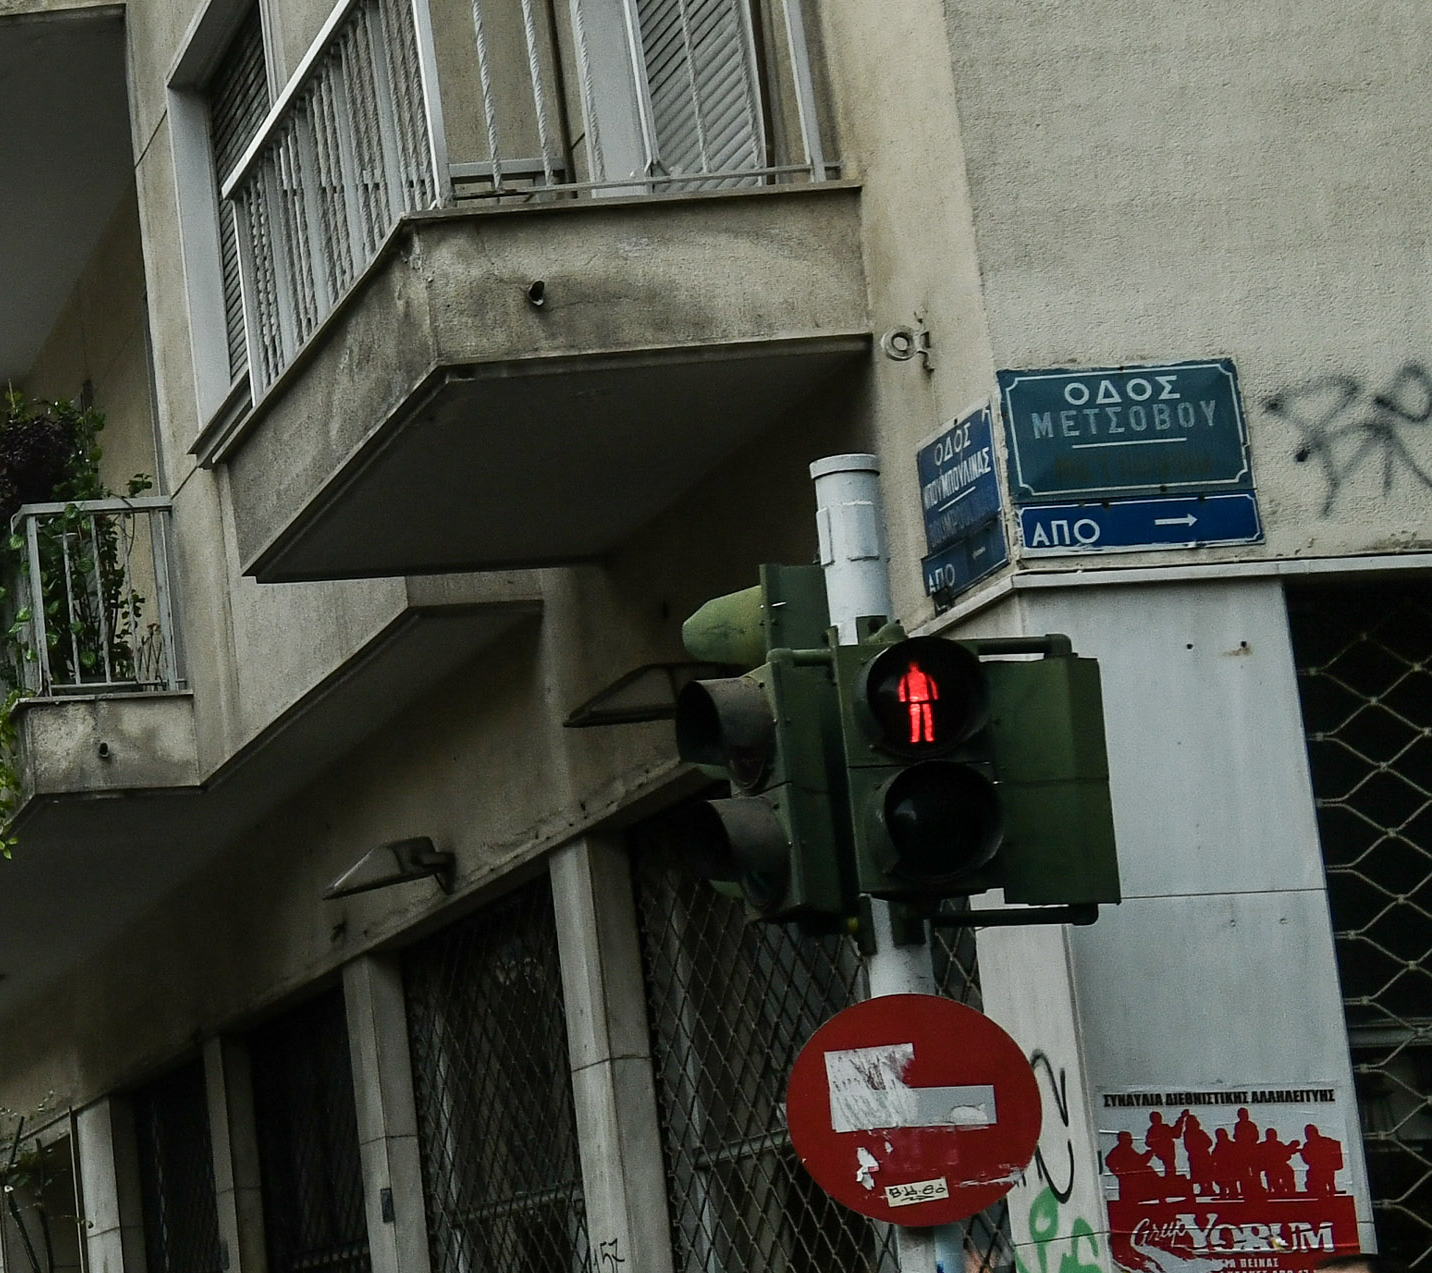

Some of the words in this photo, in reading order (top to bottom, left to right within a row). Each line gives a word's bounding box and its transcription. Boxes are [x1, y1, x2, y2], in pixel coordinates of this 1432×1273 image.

[1064, 375, 1181, 406] ΟΔΟΣ
[1031, 399, 1218, 439] ΜΕΤΣΟΒΟΥ
[934, 422, 971, 466] ΟΔΟΣ
[924, 447, 991, 510] ΜΠΟΥΜΠΟΥΛΙΝΑΣ
[1031, 517, 1101, 547] ΑΠΟ
[928, 563, 955, 594] ΑΠΟ
[1103, 1094, 1163, 1107] ΣΥΝΑΥΛΙΑ
[1165, 1092, 1249, 1106] ΔΙΕΘΝΙΣΤΙΚΗΣ
[1130, 1218, 1185, 1248] Grup
[1176, 1214, 1335, 1254] YORUM
